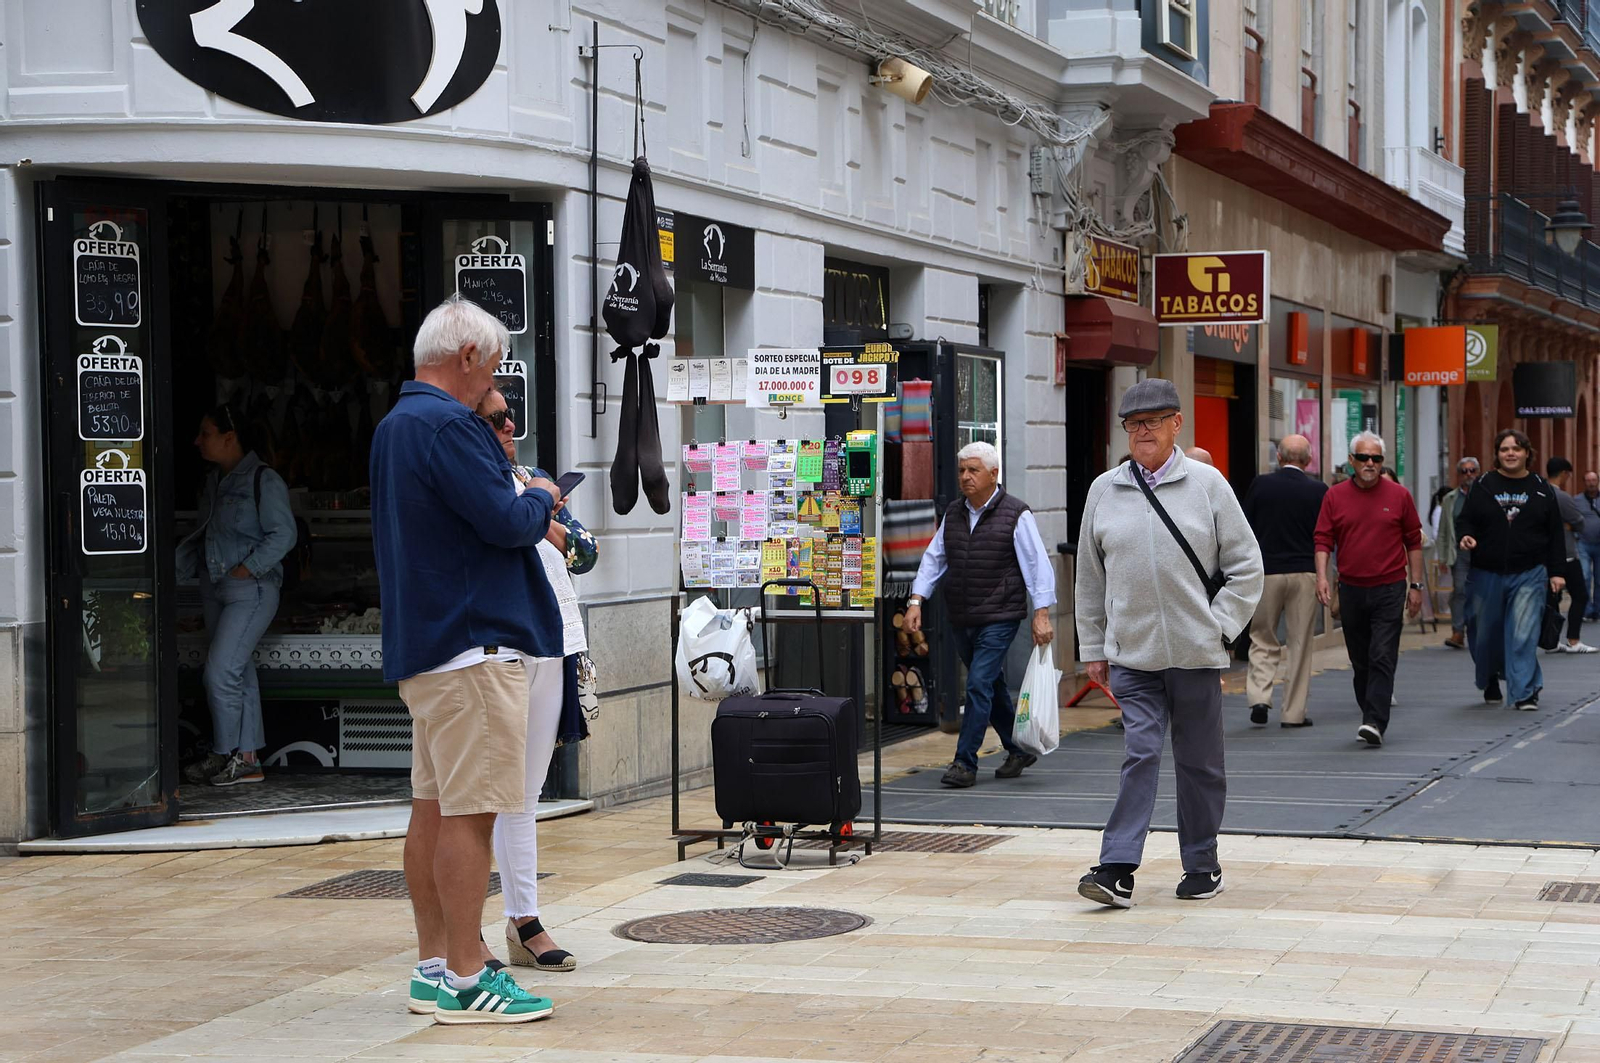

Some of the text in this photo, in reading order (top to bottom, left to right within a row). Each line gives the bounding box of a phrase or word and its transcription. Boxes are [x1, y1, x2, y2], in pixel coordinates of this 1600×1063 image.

[77, 241, 136, 256] OFERTA
[108, 261, 118, 271] DE
[459, 255, 522, 267] OFERTA
[701, 258, 707, 270] La
[1100, 244, 1137, 285] TABACOS
[612, 293, 639, 305] Serranía
[1161, 294, 1258, 314] TABACOS
[865, 343, 888, 353] EURO
[80, 356, 139, 371] OFERTA
[754, 354, 783, 363] SORTEO
[785, 354, 820, 363] ESPECIAL
[858, 352, 896, 363] JACKPOT
[755, 366, 819, 375] DIA DE LA MADRE
[85, 375, 111, 389] CAÑA
[836, 370, 879, 385] 098
[1407, 370, 1459, 385] orange
[758, 381, 815, 391] 17.000.000 €
[120, 390, 131, 399] DE
[778, 394, 803, 402] ONCE
[87, 402, 120, 413] BELLOTA
[1518, 406, 1573, 415] CALZEDONIA
[91, 414, 130, 434] 53,90
[83, 470, 142, 483] OFERTA
[87, 486, 117, 505] PALETA
[101, 522, 136, 541] 15,90
[320, 706, 340, 720] La
